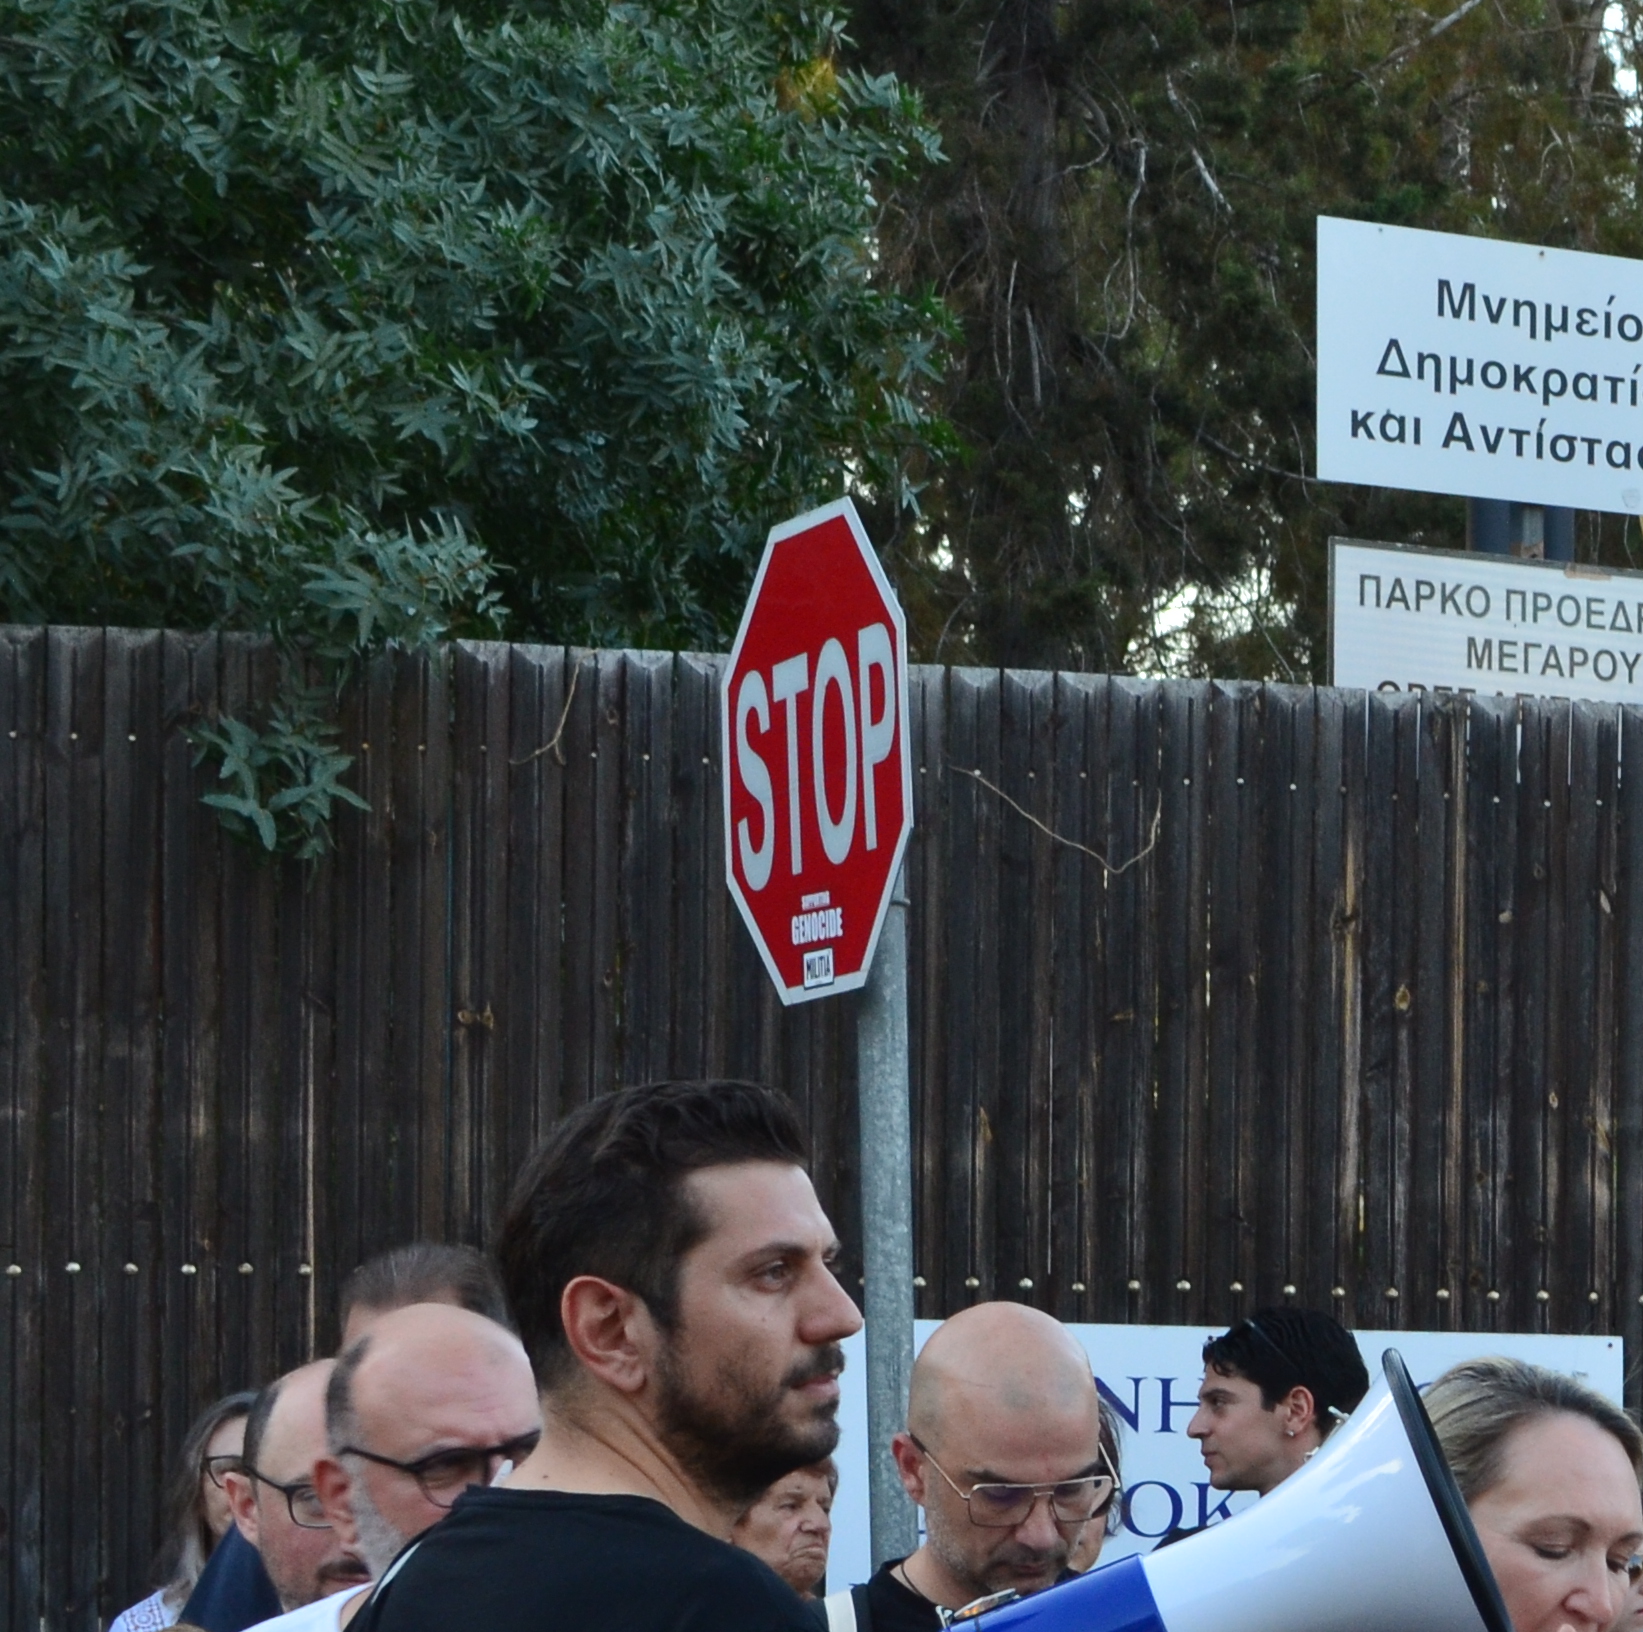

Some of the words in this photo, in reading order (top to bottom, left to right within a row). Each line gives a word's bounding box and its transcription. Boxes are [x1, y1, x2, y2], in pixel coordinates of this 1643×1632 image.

[1436, 278, 1643, 343] Μνημείο
[1350, 408, 1422, 447] και
[1358, 573, 1491, 620] ΠΑΡΚΟ
[1466, 636, 1642, 685] ΜΕΓΑΡΟΥ
[736, 621, 897, 892] STOP
[792, 907, 843, 945] GENOCIDE
